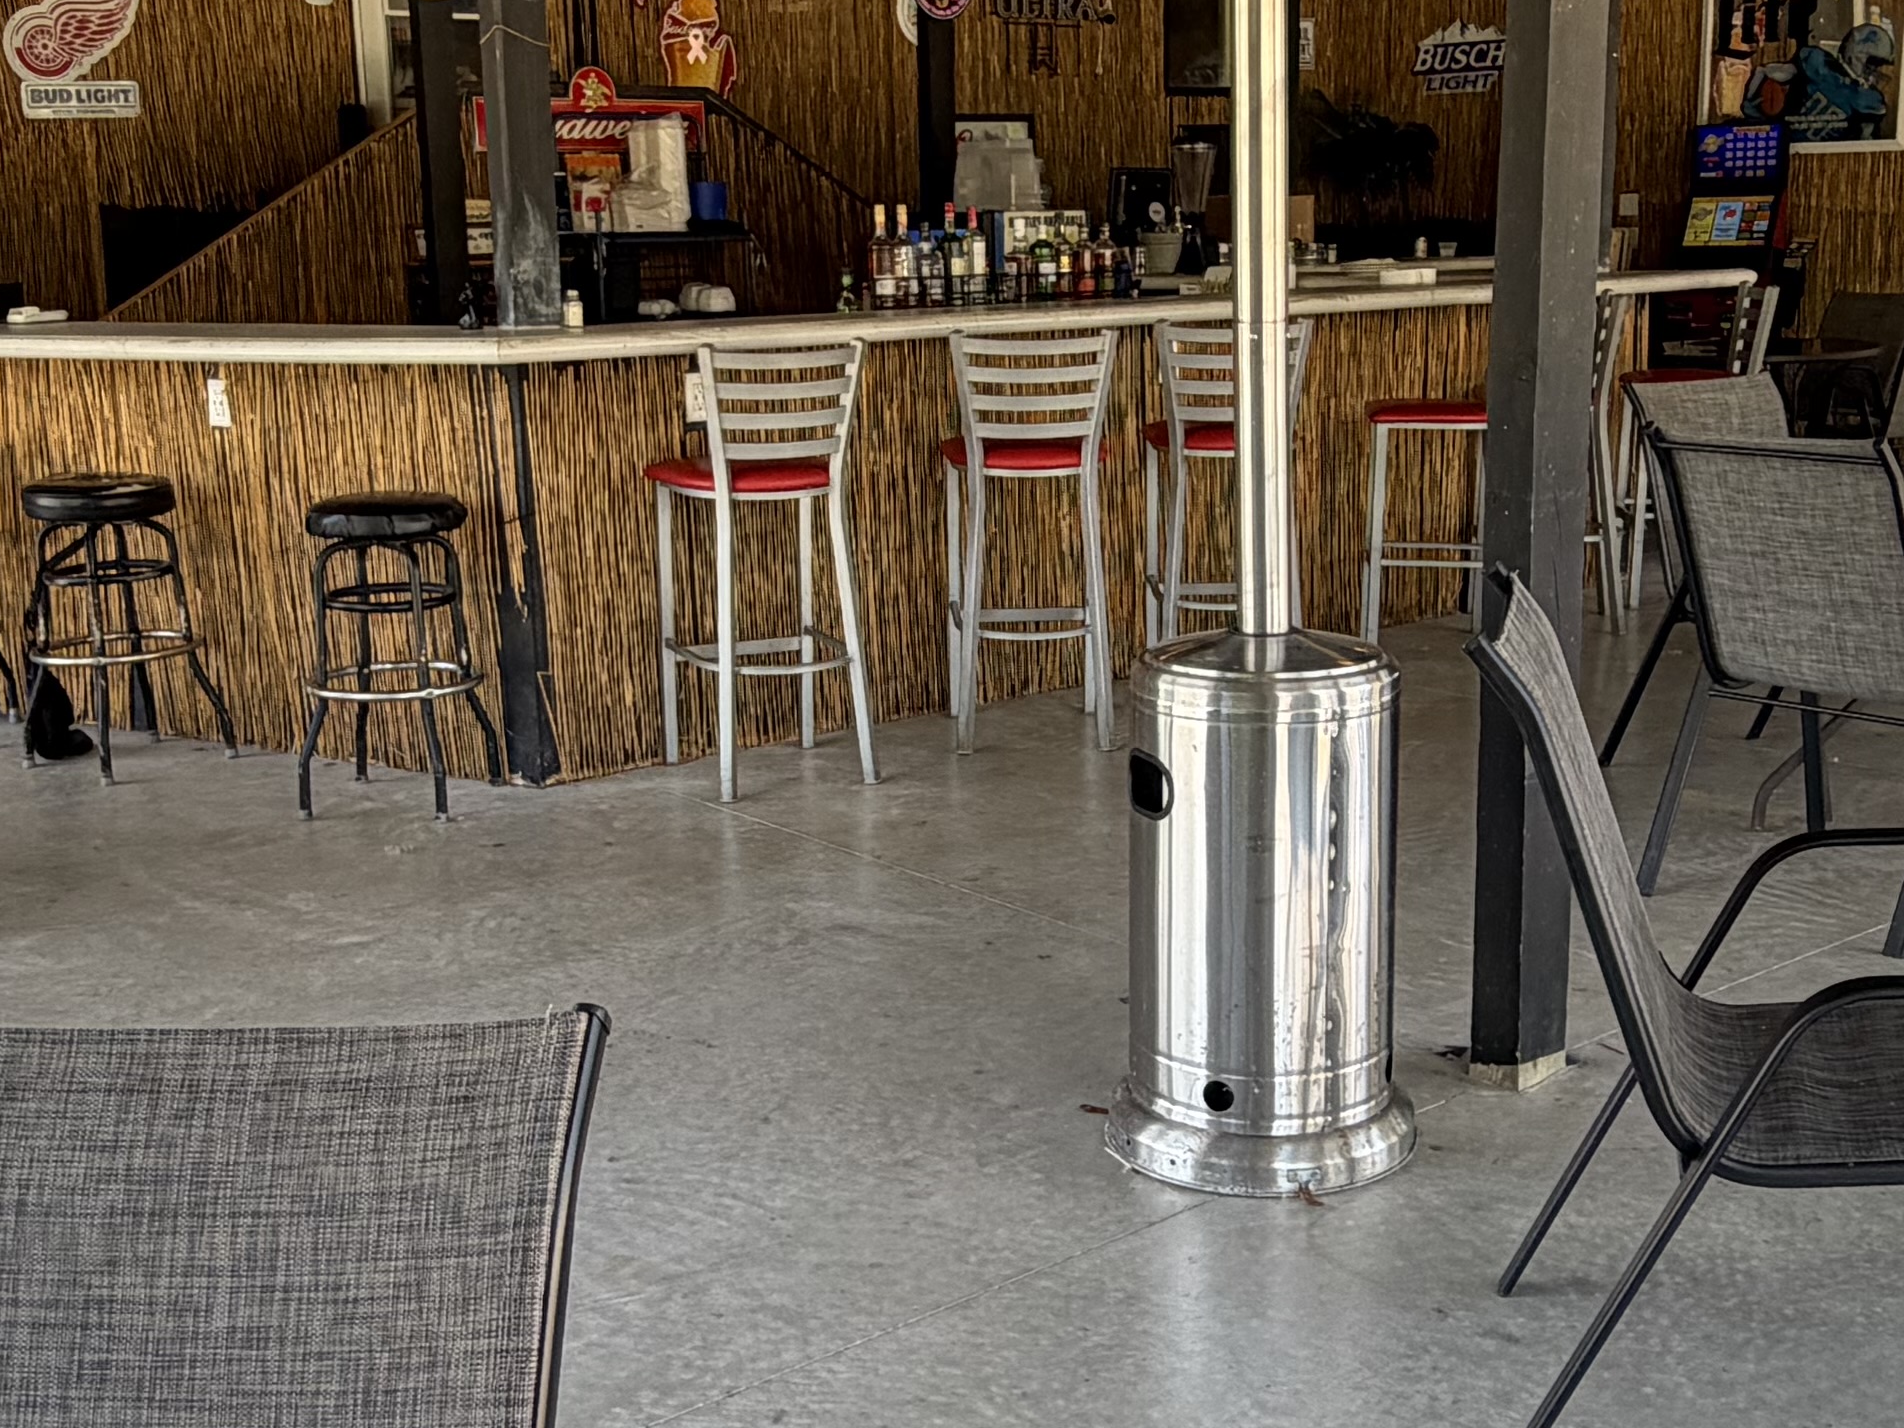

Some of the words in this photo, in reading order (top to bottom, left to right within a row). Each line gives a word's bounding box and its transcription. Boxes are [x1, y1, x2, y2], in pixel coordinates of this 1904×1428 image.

[1413, 42, 1505, 72] BUSCH
[1425, 72, 1494, 92] LIGHT
[29, 87, 74, 104] BUD
[74, 87, 133, 104] LIGHT
